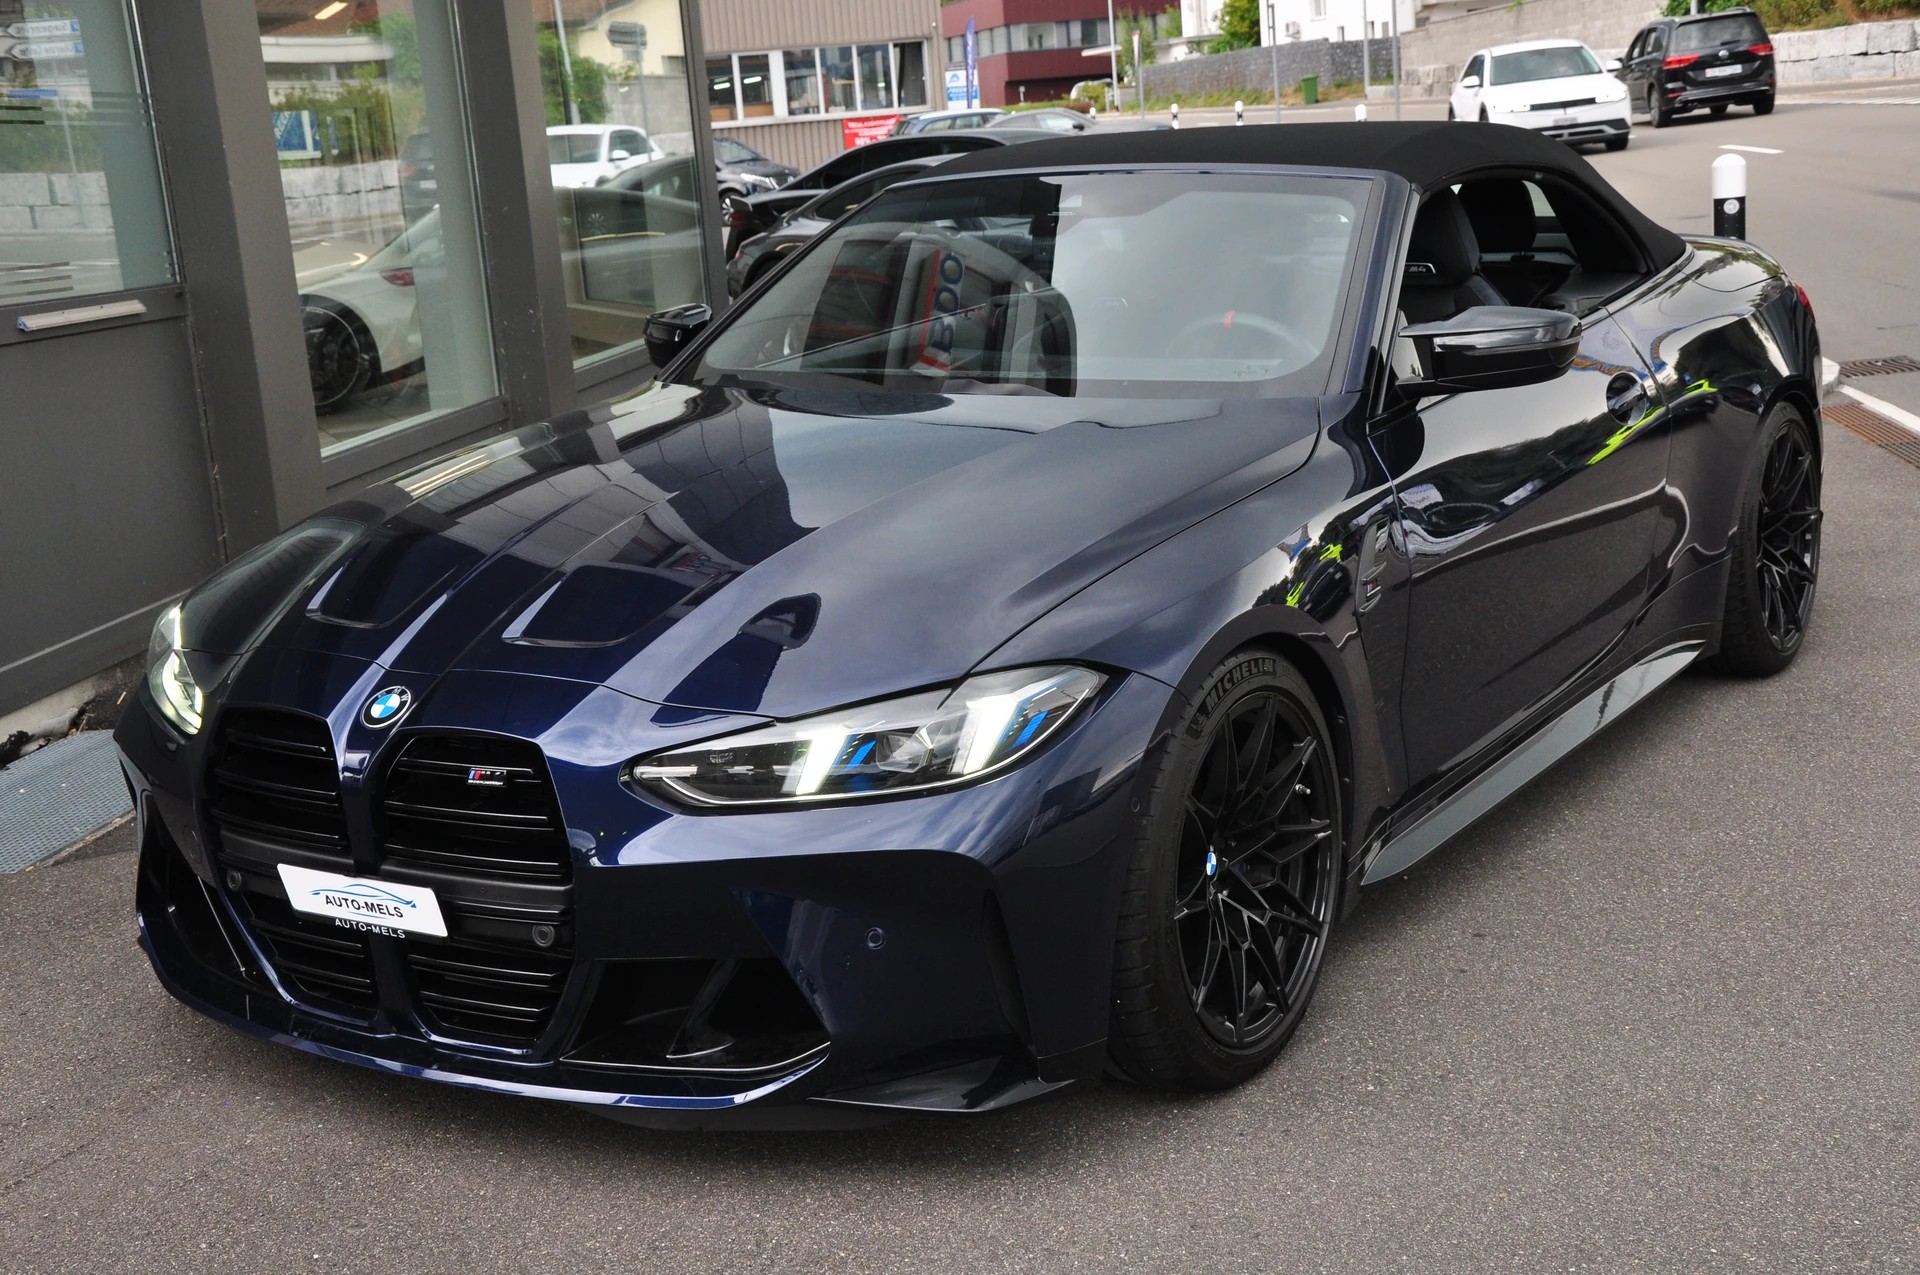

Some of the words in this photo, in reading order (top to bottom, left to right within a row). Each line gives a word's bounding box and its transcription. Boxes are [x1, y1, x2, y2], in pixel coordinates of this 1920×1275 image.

[1205, 658, 1274, 712] MICHELIN
[325, 894, 404, 918] AUTO-MELS
[335, 918, 406, 939] AUTO-MELS
